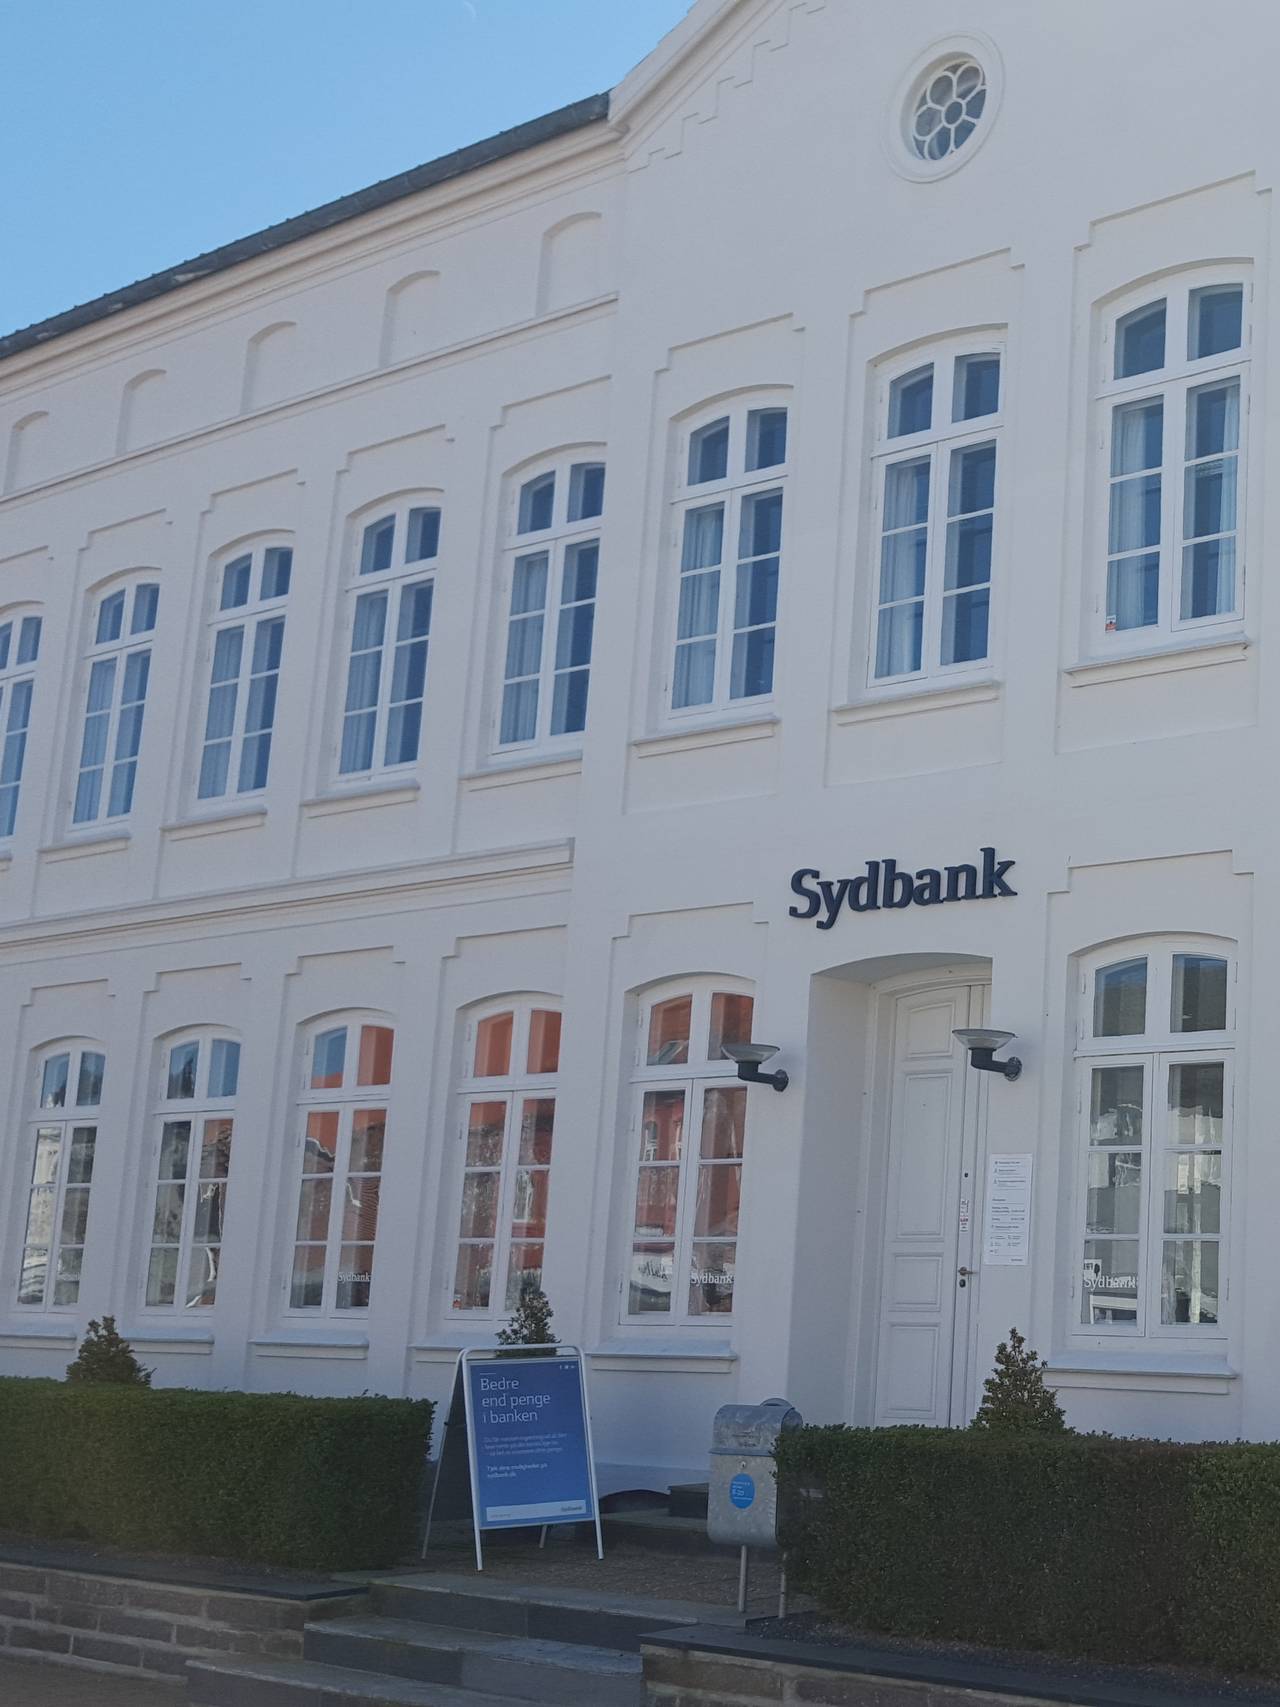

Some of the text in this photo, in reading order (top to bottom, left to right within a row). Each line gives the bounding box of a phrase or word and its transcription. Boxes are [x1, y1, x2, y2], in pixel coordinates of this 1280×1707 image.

[789, 847, 1018, 930] Sydbank
[691, 1271, 732, 1287] Sydbank
[480, 1377, 520, 1391] Bedre
[482, 1393, 551, 1409] end penge
[490, 1409, 538, 1424] banken
